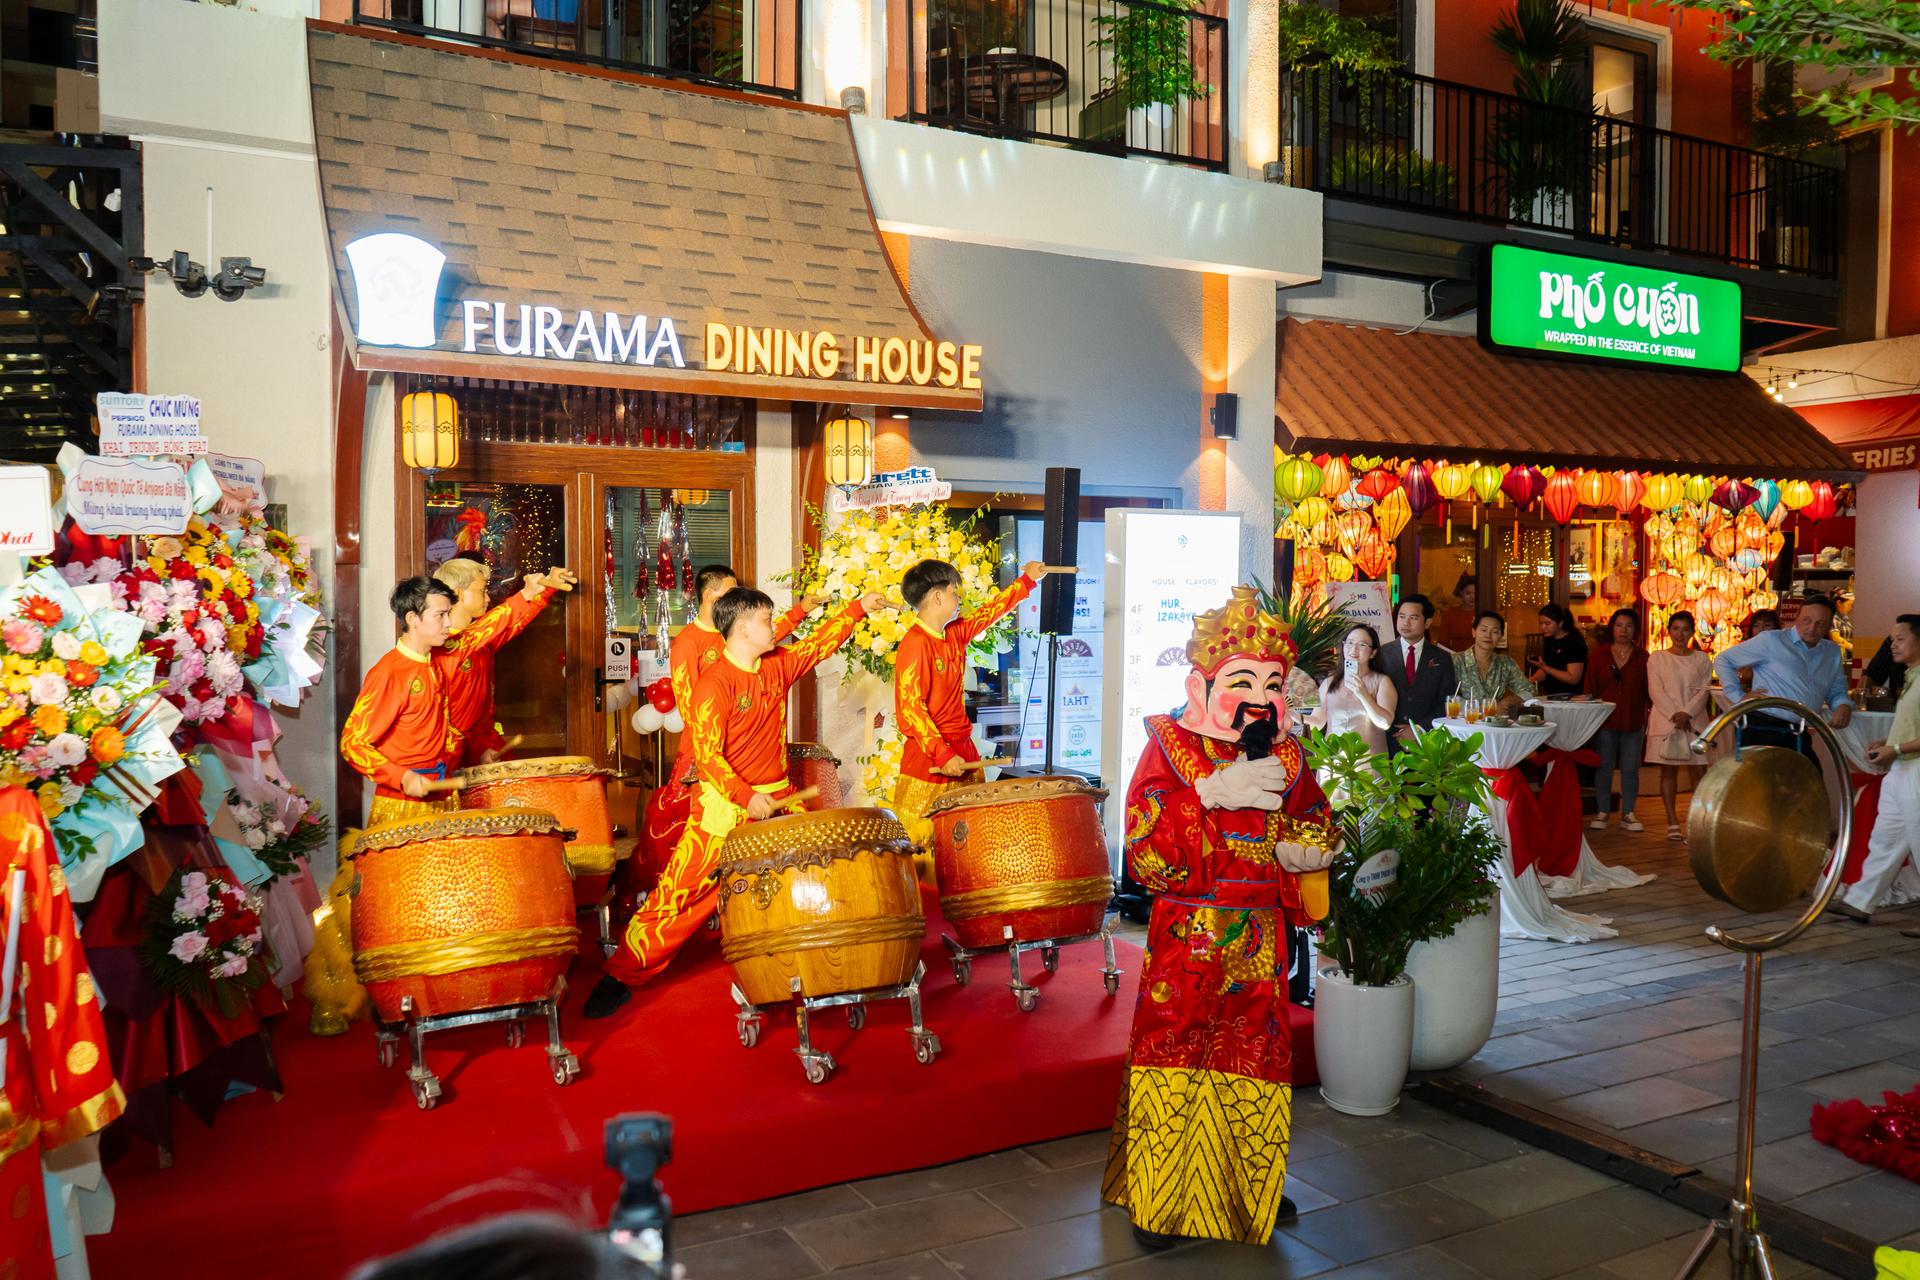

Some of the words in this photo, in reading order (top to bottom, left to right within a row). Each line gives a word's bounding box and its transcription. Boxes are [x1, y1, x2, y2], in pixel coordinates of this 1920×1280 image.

[462, 300, 687, 368] FURAMA
[704, 322, 840, 378] DINING
[854, 334, 983, 389] HOUSE
[1544, 330, 1587, 347] WRAPPED
[1587, 336, 1597, 348] IN
[1597, 337, 1613, 349] THE
[1614, 339, 1649, 355] ESSENCE
[1649, 342, 1660, 355] OF
[1661, 343, 1696, 360] VIETNAM
[117, 424, 148, 436] FURAMA
[149, 424, 174, 437] DINING
[175, 424, 197, 437] HOUSE
[1852, 444, 1916, 469] FRIES
[871, 468, 931, 482] arett
[899, 478, 932, 486] ZONE
[1185, 578, 1217, 586] FLAVORS
[1131, 605, 1144, 614] 4F
[1130, 656, 1141, 664] 3F
[1128, 707, 1141, 716] 2F
[1127, 757, 1137, 766] 1F
